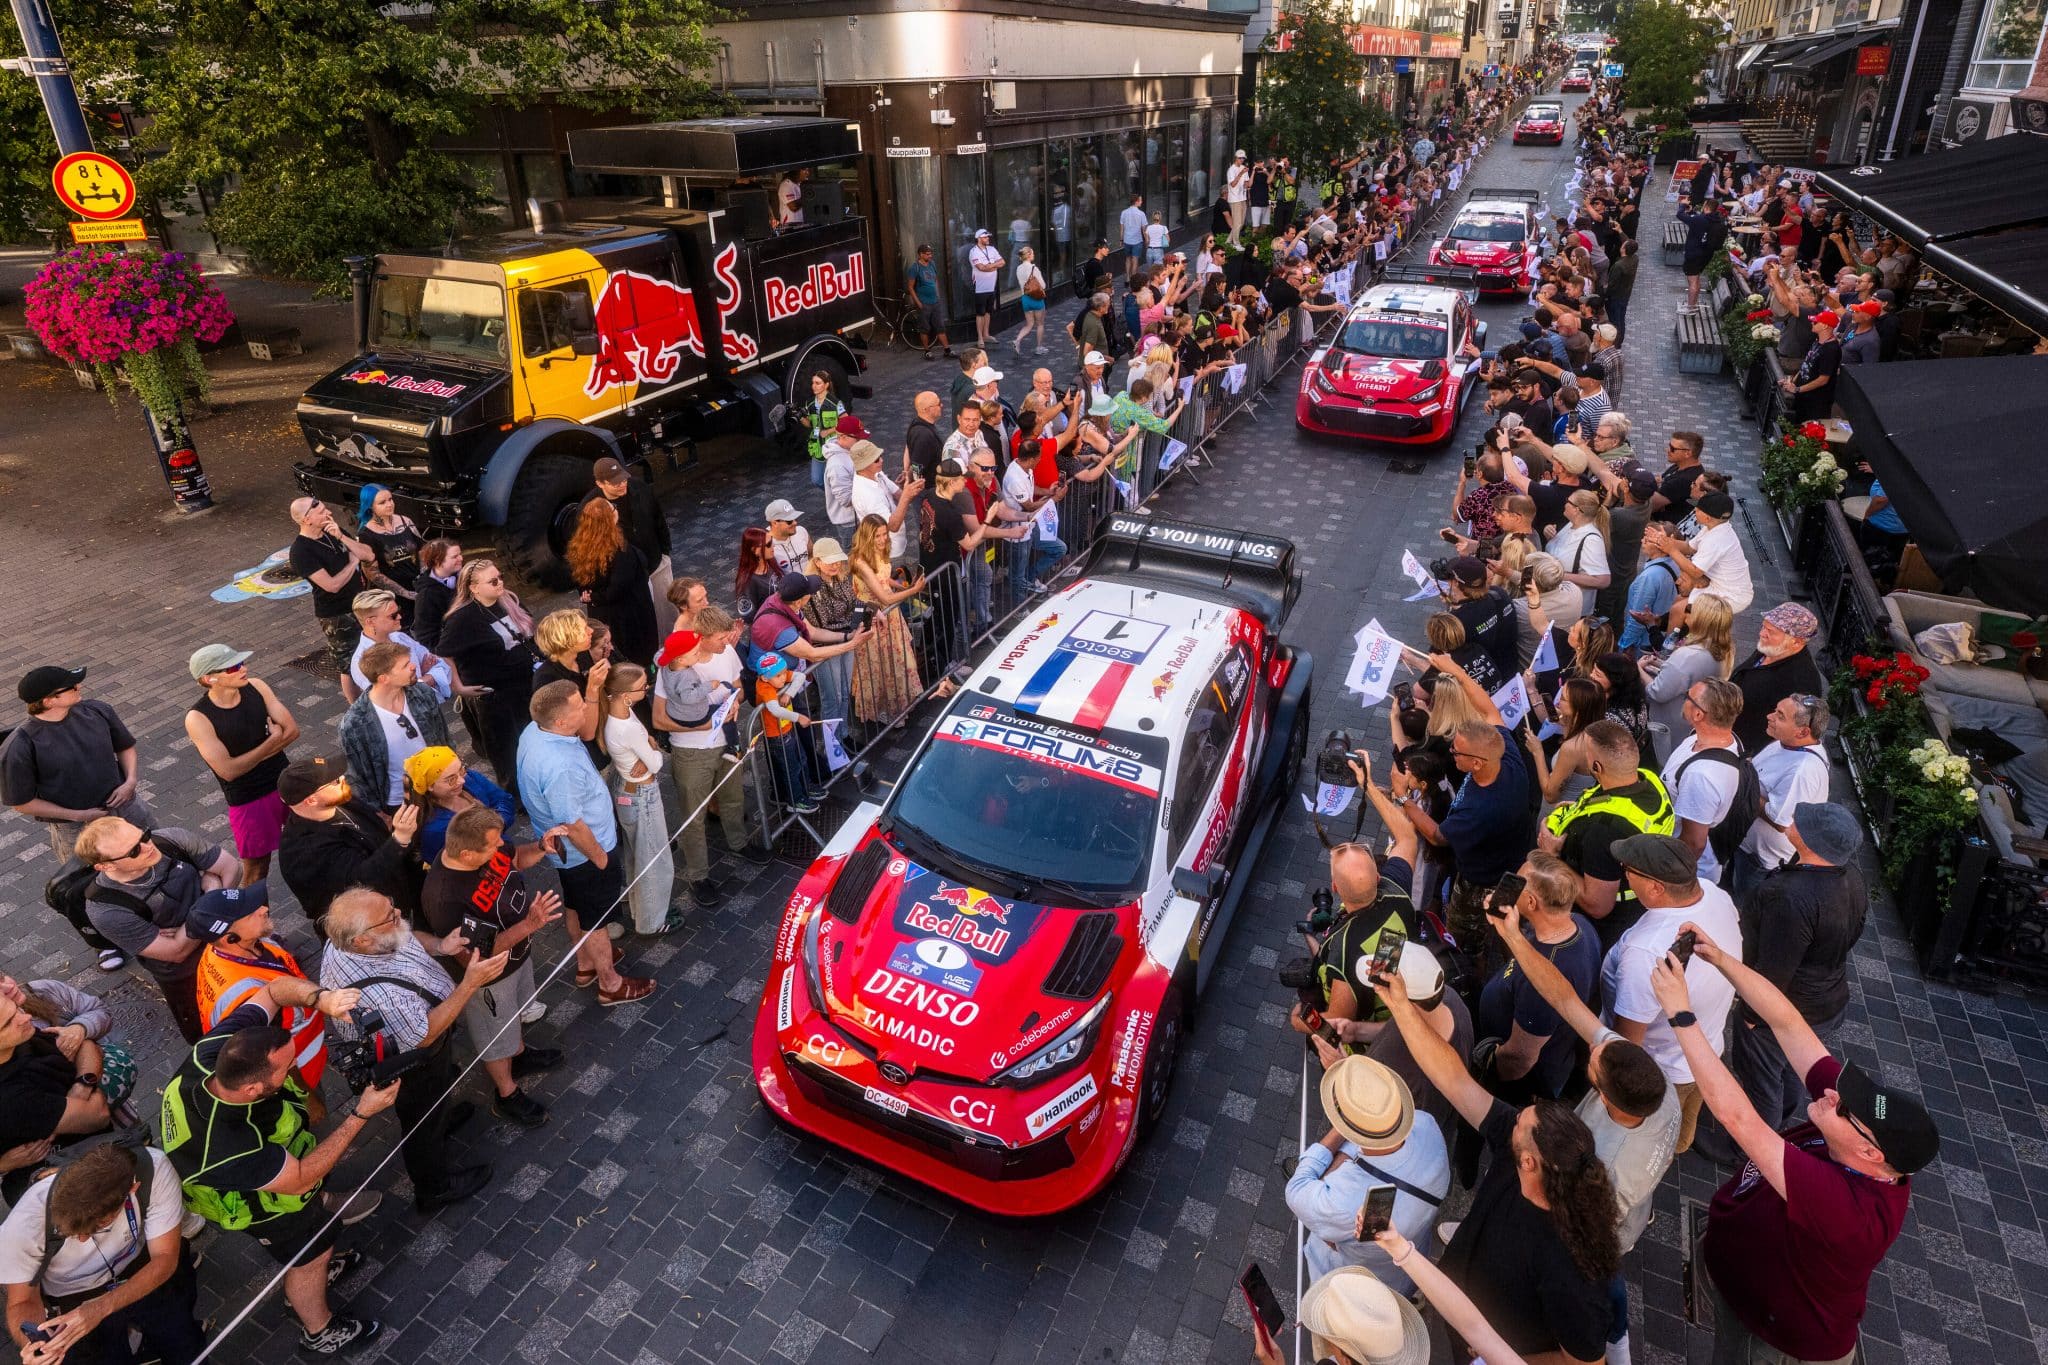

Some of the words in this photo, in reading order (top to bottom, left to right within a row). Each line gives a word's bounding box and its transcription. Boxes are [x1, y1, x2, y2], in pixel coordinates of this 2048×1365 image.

[78, 165, 89, 178] 8
[94, 164, 102, 177] t
[887, 148, 929, 156] Kauppakatu
[764, 264, 820, 322] Red
[817, 251, 866, 306] Bull
[388, 375, 428, 393] Red
[423, 379, 467, 399] Bull
[1352, 373, 1399, 385] DENSO
[1111, 520, 1158, 538] GIVS
[1162, 528, 1199, 545] YOU
[1013, 634, 1040, 652] Red
[1072, 640, 1134, 659] secto
[1103, 620, 1129, 640] 1
[998, 650, 1023, 671] Bull
[968, 706, 993, 720] GR
[995, 713, 1044, 730] TOYOTA
[1044, 725, 1095, 744] GAZOO
[1095, 738, 1142, 760] Racing
[980, 725, 1143, 783] FORUM8
[892, 862, 902, 872] E
[1199, 820, 1224, 874] secto
[776, 891, 802, 961] AUTOMOTIVE
[784, 895, 812, 963] Panasonic
[904, 901, 961, 937] Red
[952, 917, 1010, 957] Bull
[1148, 888, 1175, 934] TAMADIC
[937, 945, 948, 963] 1
[863, 968, 980, 1027] DENSO
[862, 1007, 956, 1056] TAMADIC
[1009, 1008, 1073, 1055] codebeamer
[1111, 1009, 1141, 1087] Panasonic
[1126, 1010, 1153, 1093] AUTOMOTIVE
